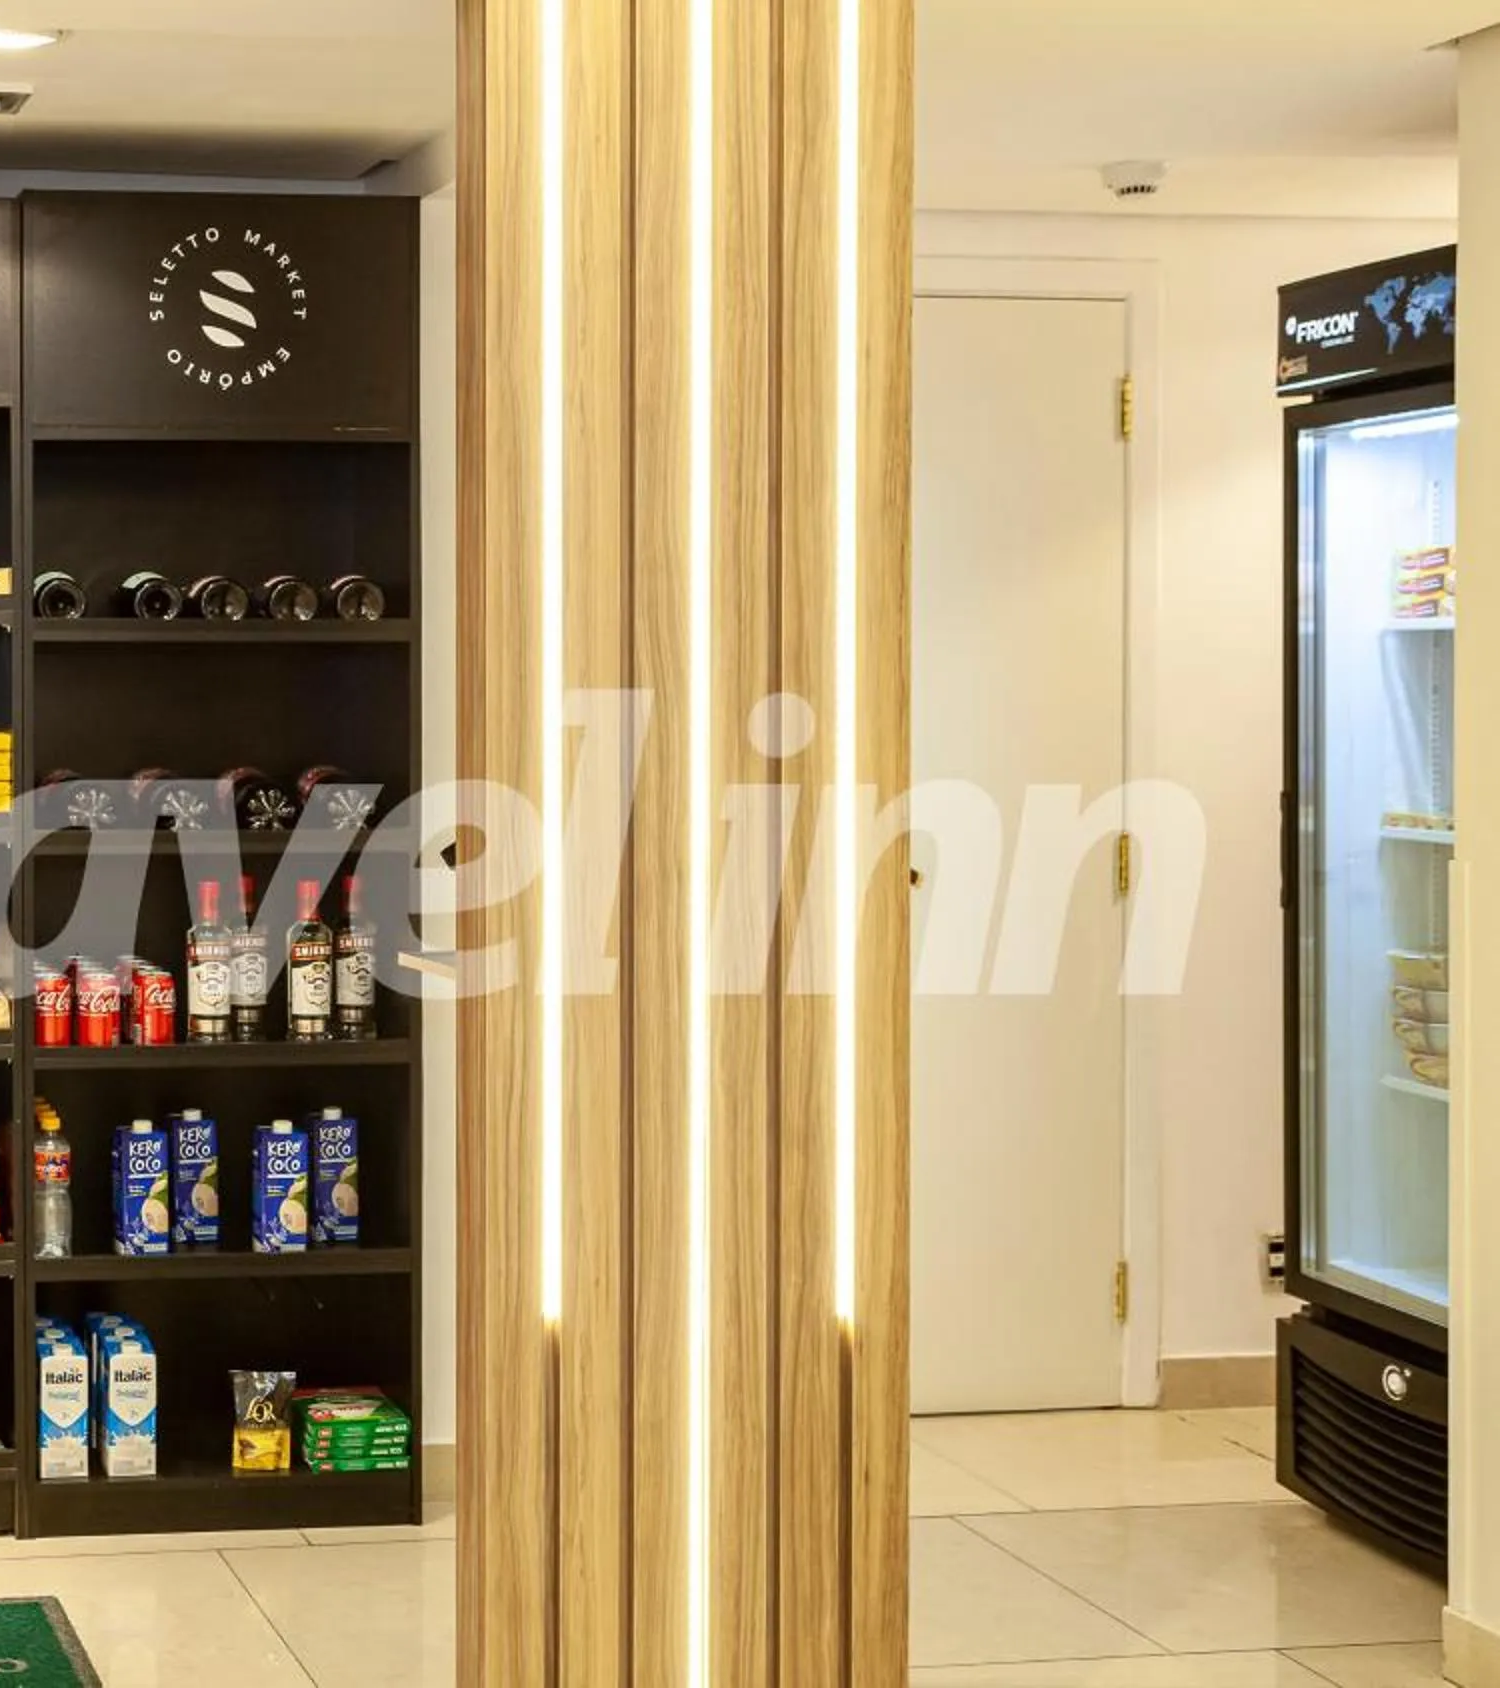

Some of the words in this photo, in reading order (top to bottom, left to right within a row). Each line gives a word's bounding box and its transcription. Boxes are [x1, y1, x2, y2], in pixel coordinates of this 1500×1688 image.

[149, 227, 219, 322] SELETTO
[243, 229, 307, 321] MARKET
[1295, 311, 1358, 344] FRICON
[166, 346, 291, 391] EMPÓRIO
[179, 1126, 211, 1142] KERO
[319, 1126, 352, 1142] KERO
[128, 1140, 163, 1158] KERO
[267, 1140, 302, 1157] KERO
